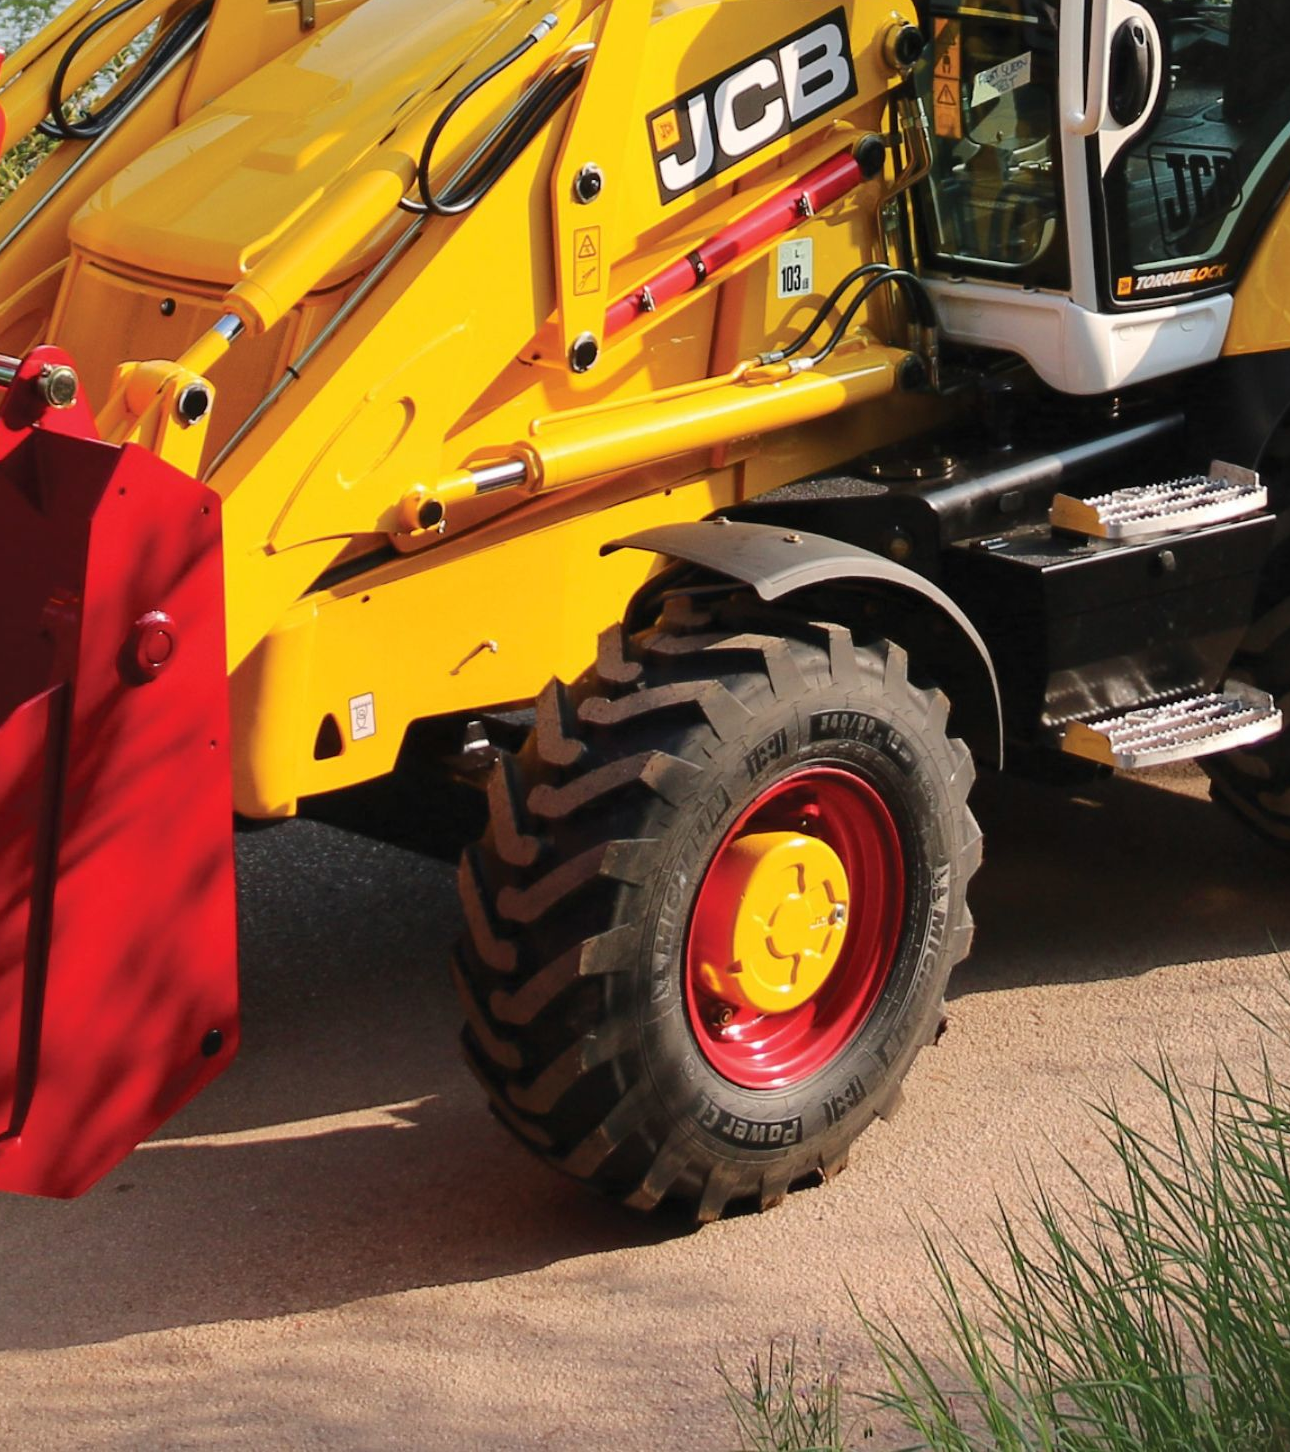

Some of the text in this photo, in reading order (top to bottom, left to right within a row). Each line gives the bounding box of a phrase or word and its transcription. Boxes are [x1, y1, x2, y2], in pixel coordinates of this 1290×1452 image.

[659, 23, 850, 191] JCB
[781, 264, 801, 292] 103
[1135, 263, 1228, 291] TORQUELOCK
